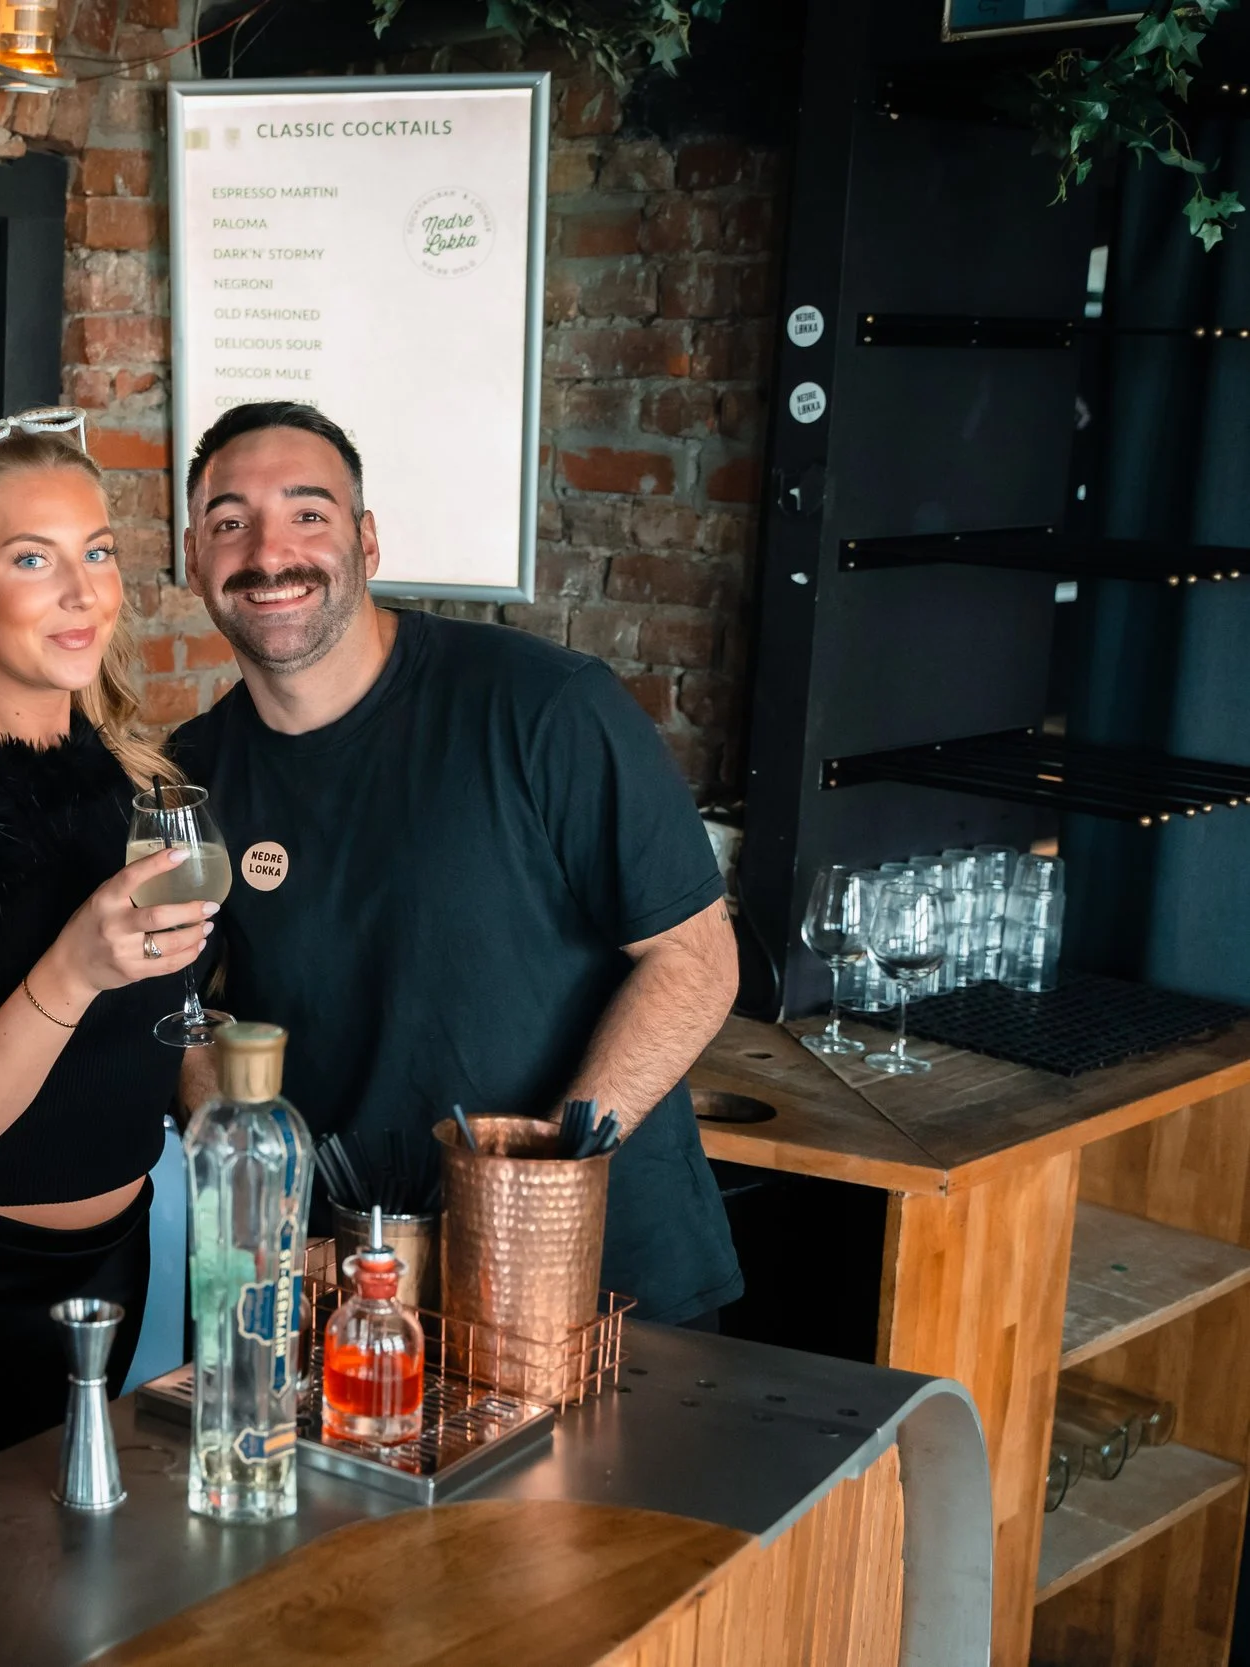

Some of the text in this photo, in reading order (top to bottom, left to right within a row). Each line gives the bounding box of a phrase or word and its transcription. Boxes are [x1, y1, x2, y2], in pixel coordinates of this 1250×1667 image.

[257, 119, 453, 138] CLASSIC COCKTAILS
[212, 186, 338, 199] ESPRESSO MARTINI
[213, 217, 268, 230] PALOMA
[422, 212, 476, 236] Nedre
[269, 248, 324, 260] STORMY
[213, 278, 274, 290] NEGRONI
[214, 307, 321, 321] OLD FASHIONED
[214, 337, 323, 351] DELICIOUS SOUR
[275, 368, 312, 380] MULE
[251, 851, 283, 864] NEDRE
